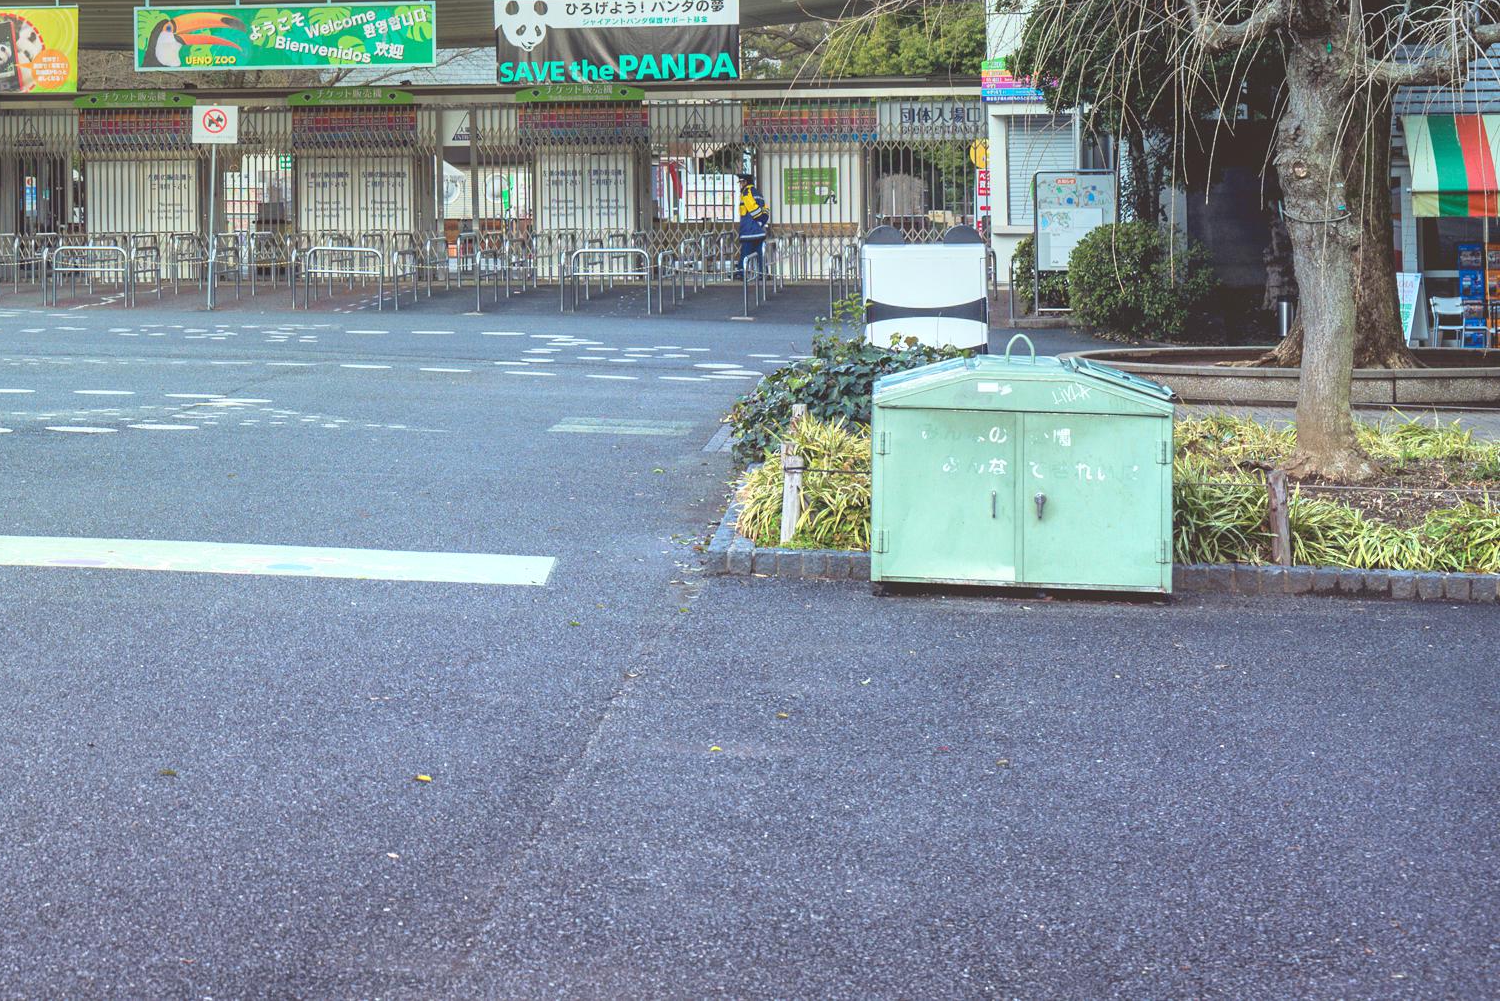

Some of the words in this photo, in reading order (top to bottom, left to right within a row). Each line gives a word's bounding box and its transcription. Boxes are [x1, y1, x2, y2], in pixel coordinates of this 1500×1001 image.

[249, 12, 306, 41] ようこそ
[304, 9, 377, 39] Welcome
[363, 8, 429, 39] 환영합니다
[185, 56, 213, 65] UENO
[215, 55, 236, 65] ZOO
[275, 35, 372, 64] Bienvenidos
[373, 42, 404, 60] 欢迎
[500, 60, 565, 83] SAVE
[569, 59, 615, 82] the
[619, 51, 738, 81] PANDA
[546, 85, 613, 95] チケット販売機
[901, 107, 981, 123] 団体入場口
